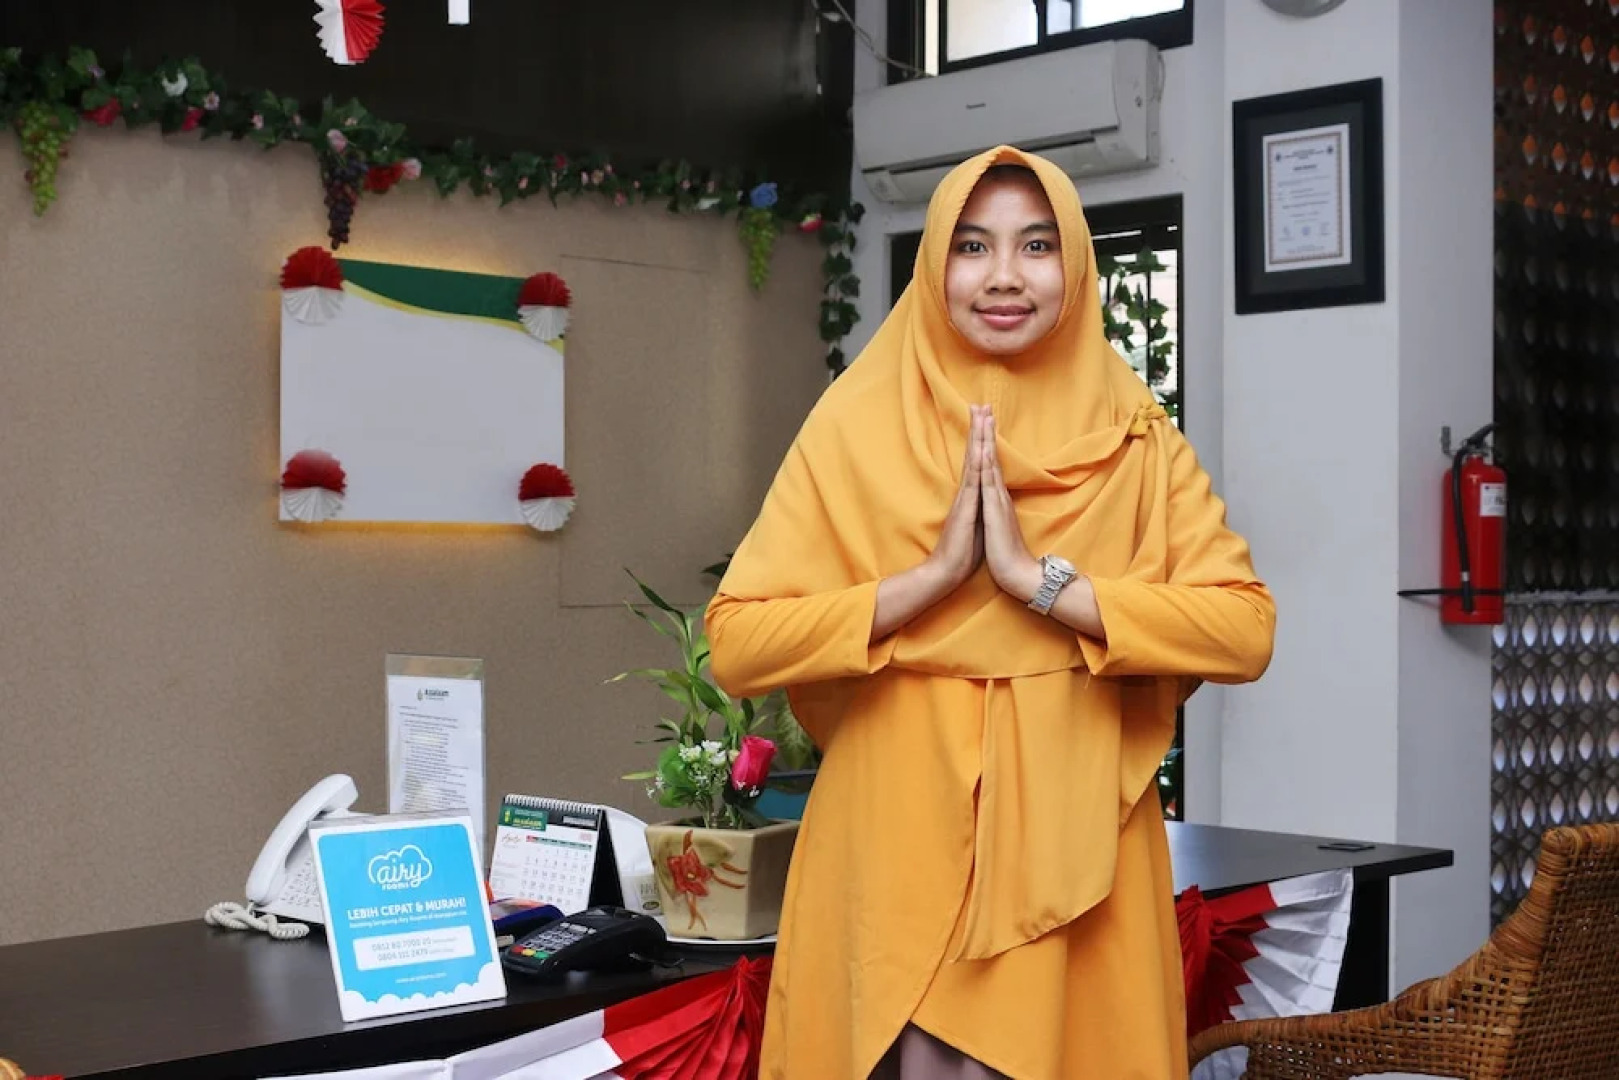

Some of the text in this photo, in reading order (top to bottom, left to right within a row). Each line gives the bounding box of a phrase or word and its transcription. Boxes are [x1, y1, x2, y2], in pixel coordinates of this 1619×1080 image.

[377, 858, 421, 888] airy
[347, 897, 466, 920] LEBIH CEPAT & MURAH!
